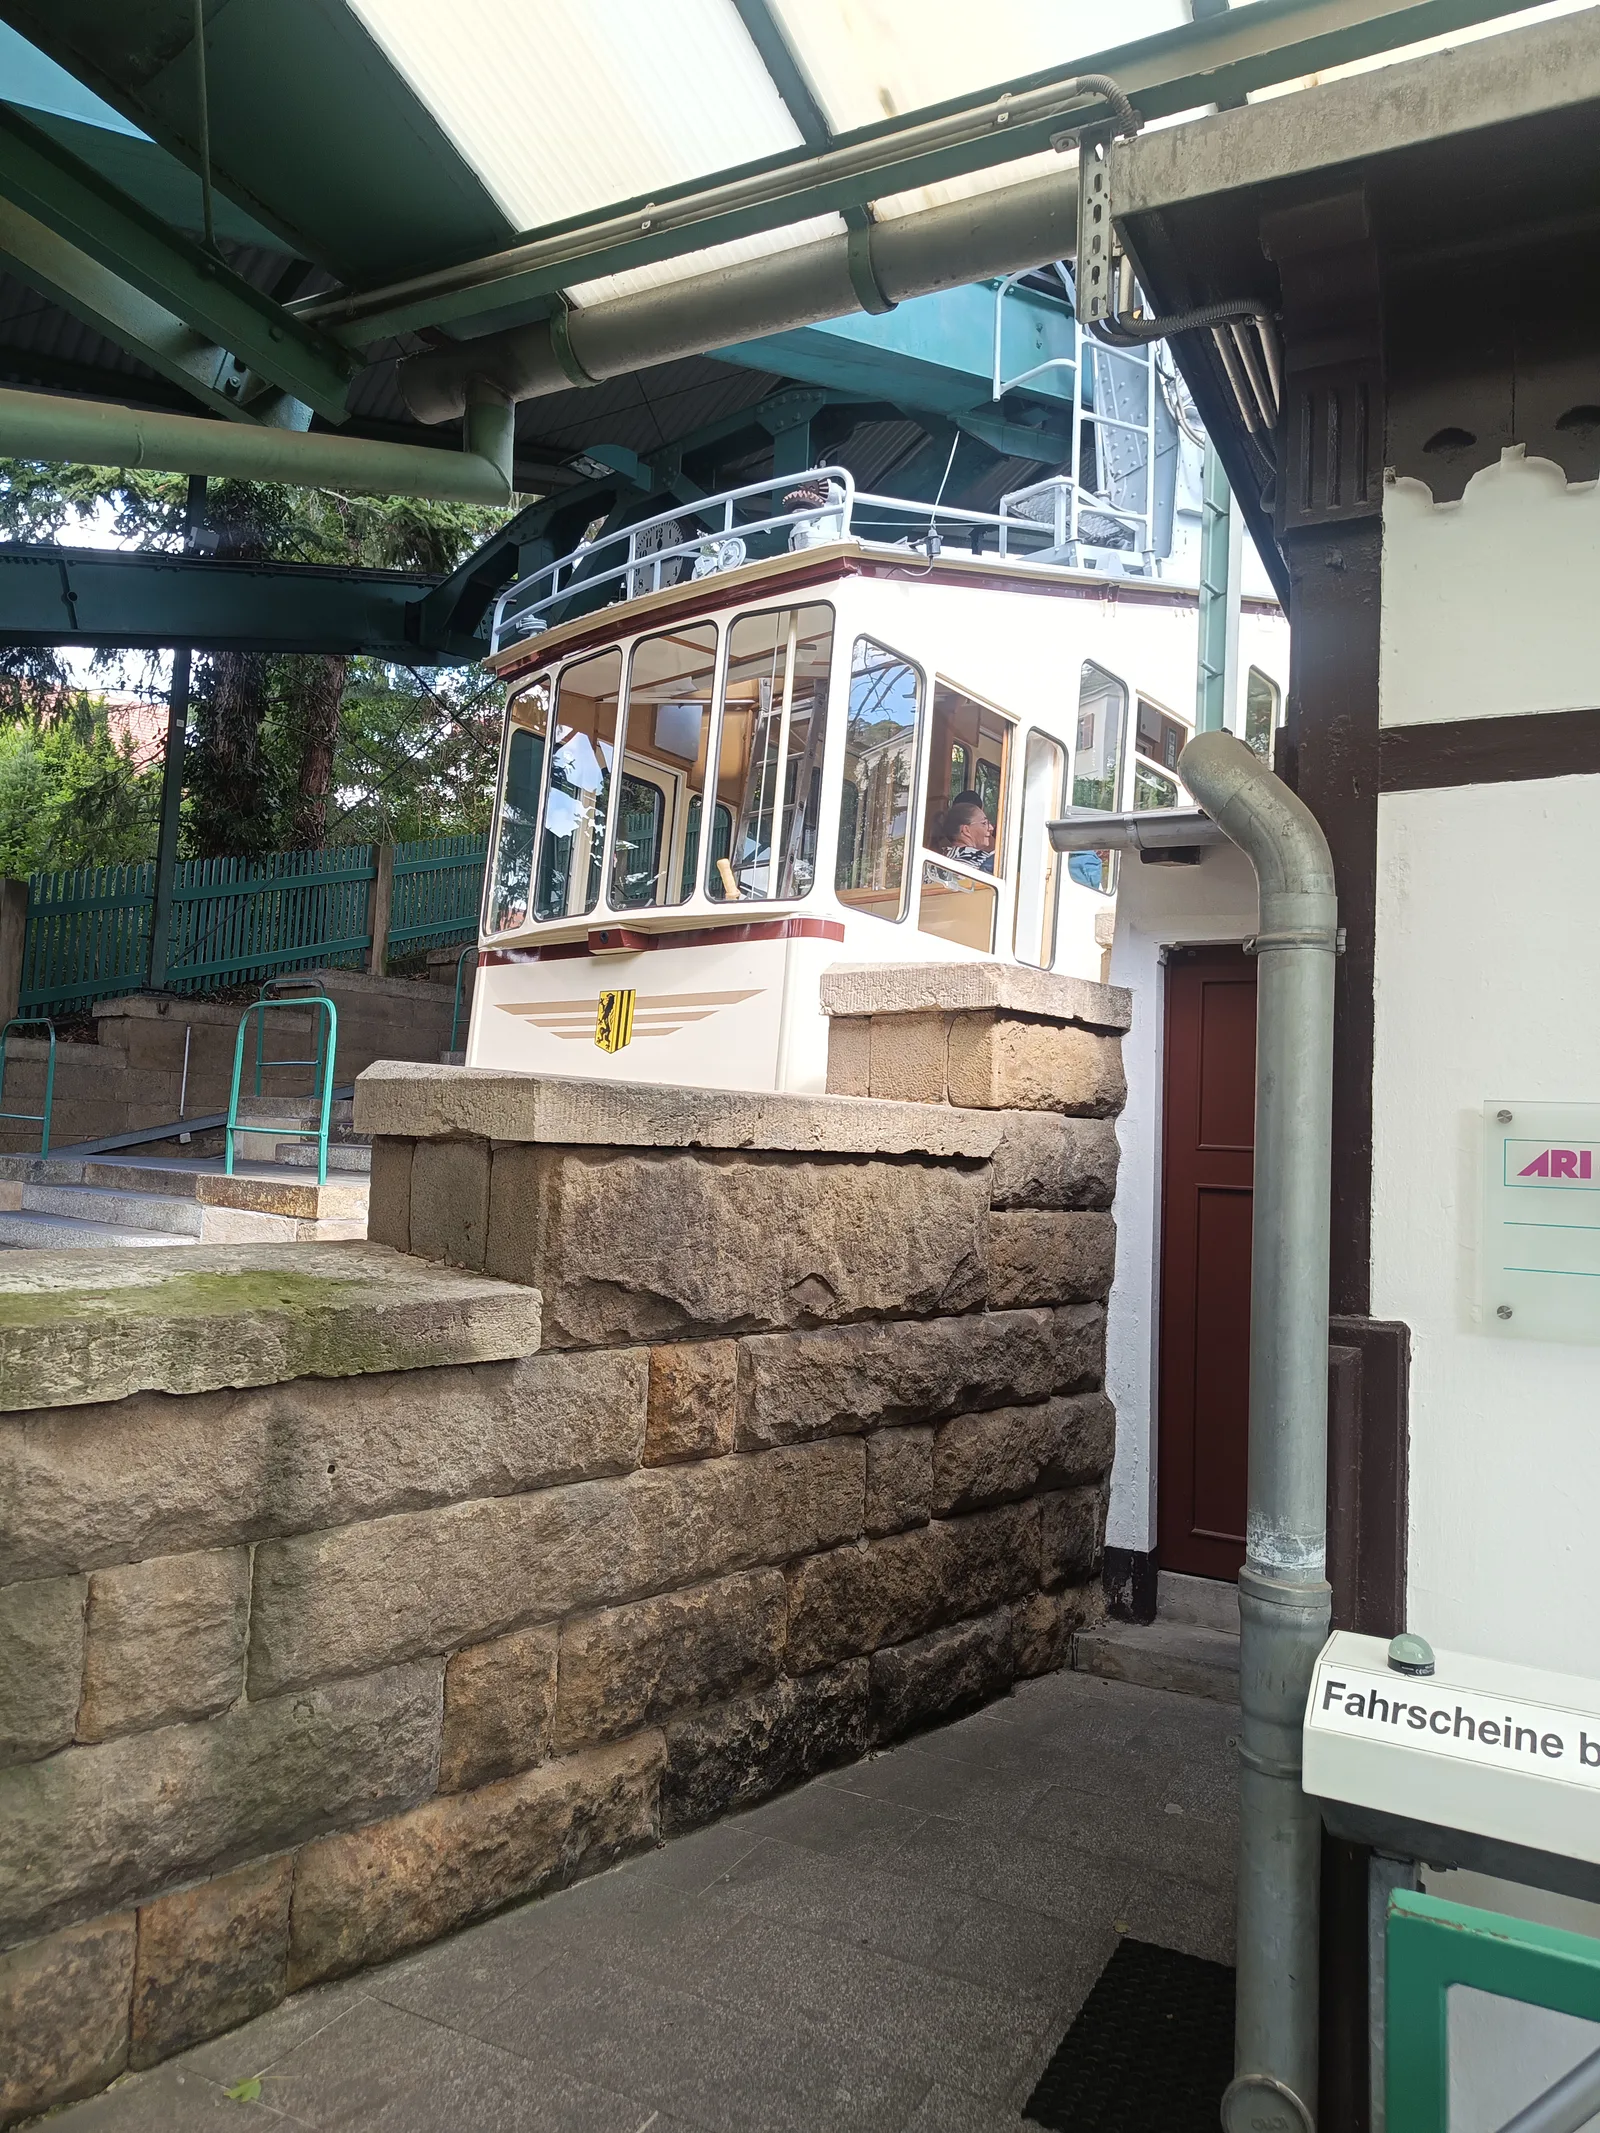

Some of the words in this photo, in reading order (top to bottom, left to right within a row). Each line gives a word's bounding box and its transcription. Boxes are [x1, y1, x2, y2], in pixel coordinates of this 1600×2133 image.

[655, 528, 663, 540] 12
[668, 529, 672, 539] 1
[646, 537, 652, 548] 11
[673, 566, 678, 577] 4
[638, 579, 643, 589] 8
[1516, 1149, 1592, 1179] ARI
[1322, 1680, 1564, 1758] Fahrscheine
[1580, 1731, 1600, 1767] b
